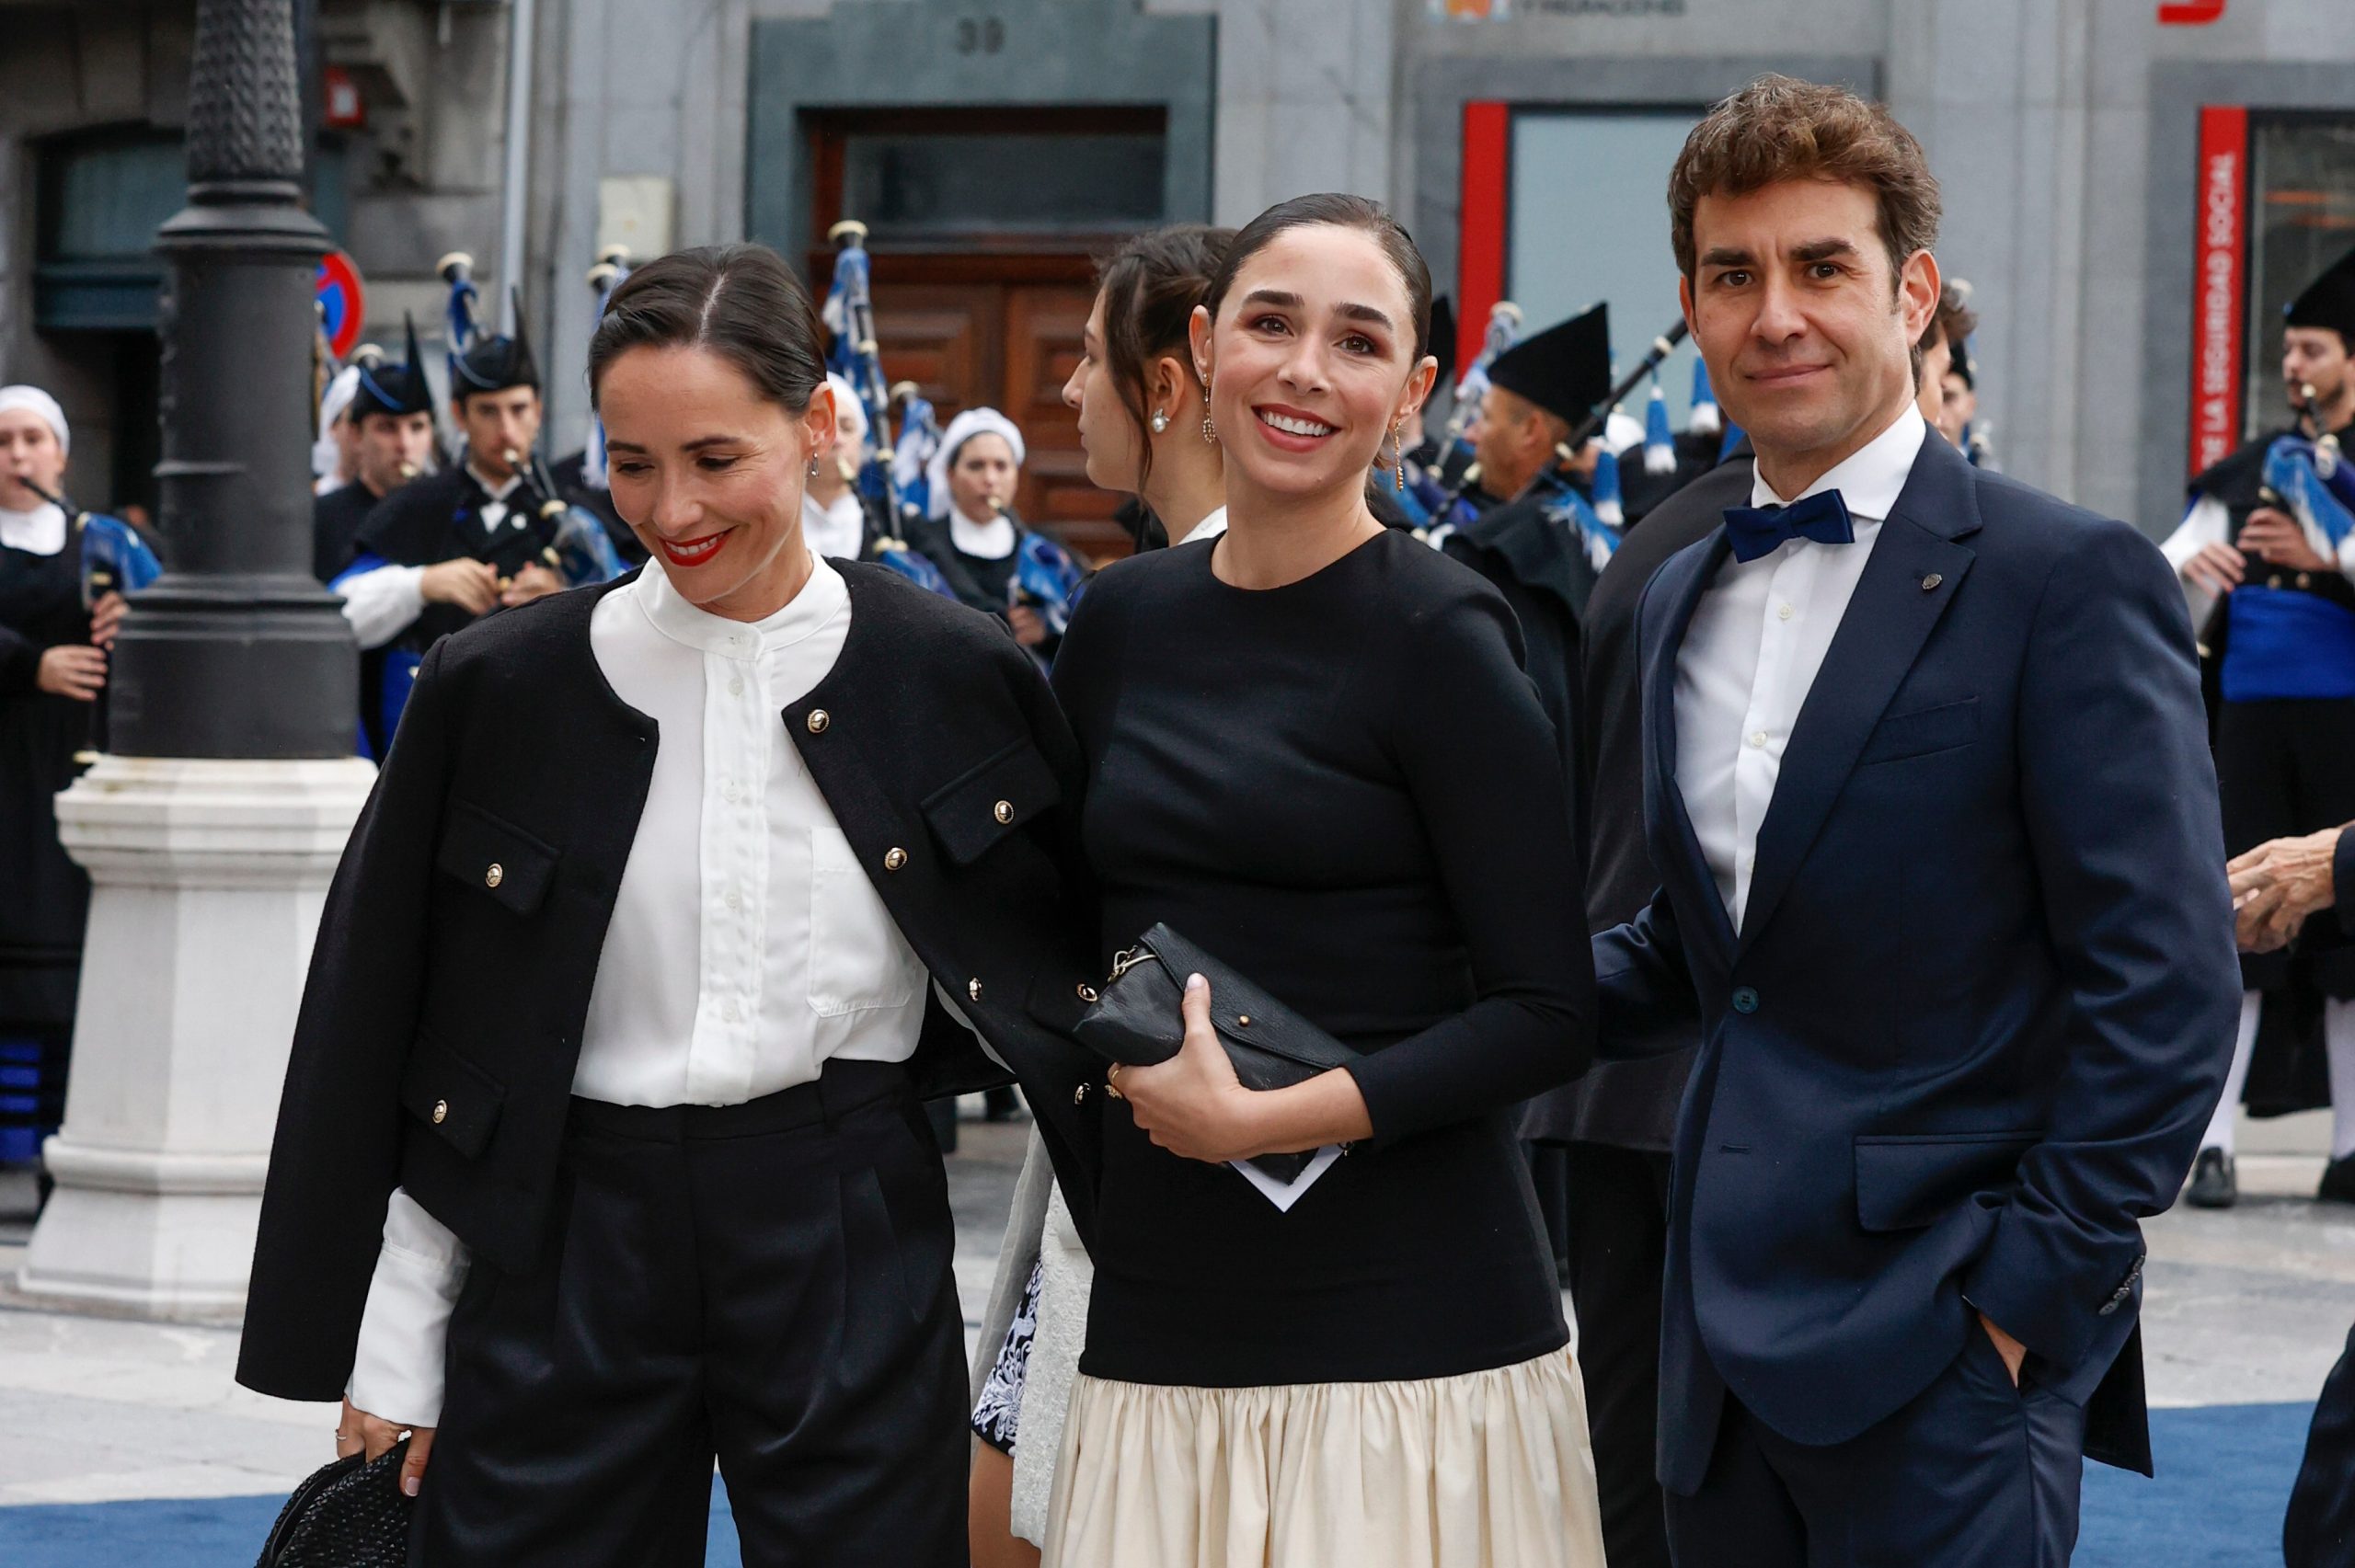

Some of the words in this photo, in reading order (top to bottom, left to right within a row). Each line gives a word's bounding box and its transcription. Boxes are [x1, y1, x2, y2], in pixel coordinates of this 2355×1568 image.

[2208, 152, 2234, 247] SOCIAL
[2203, 249, 2232, 395] SEGURIDAD
[2203, 397, 2226, 432] LA
